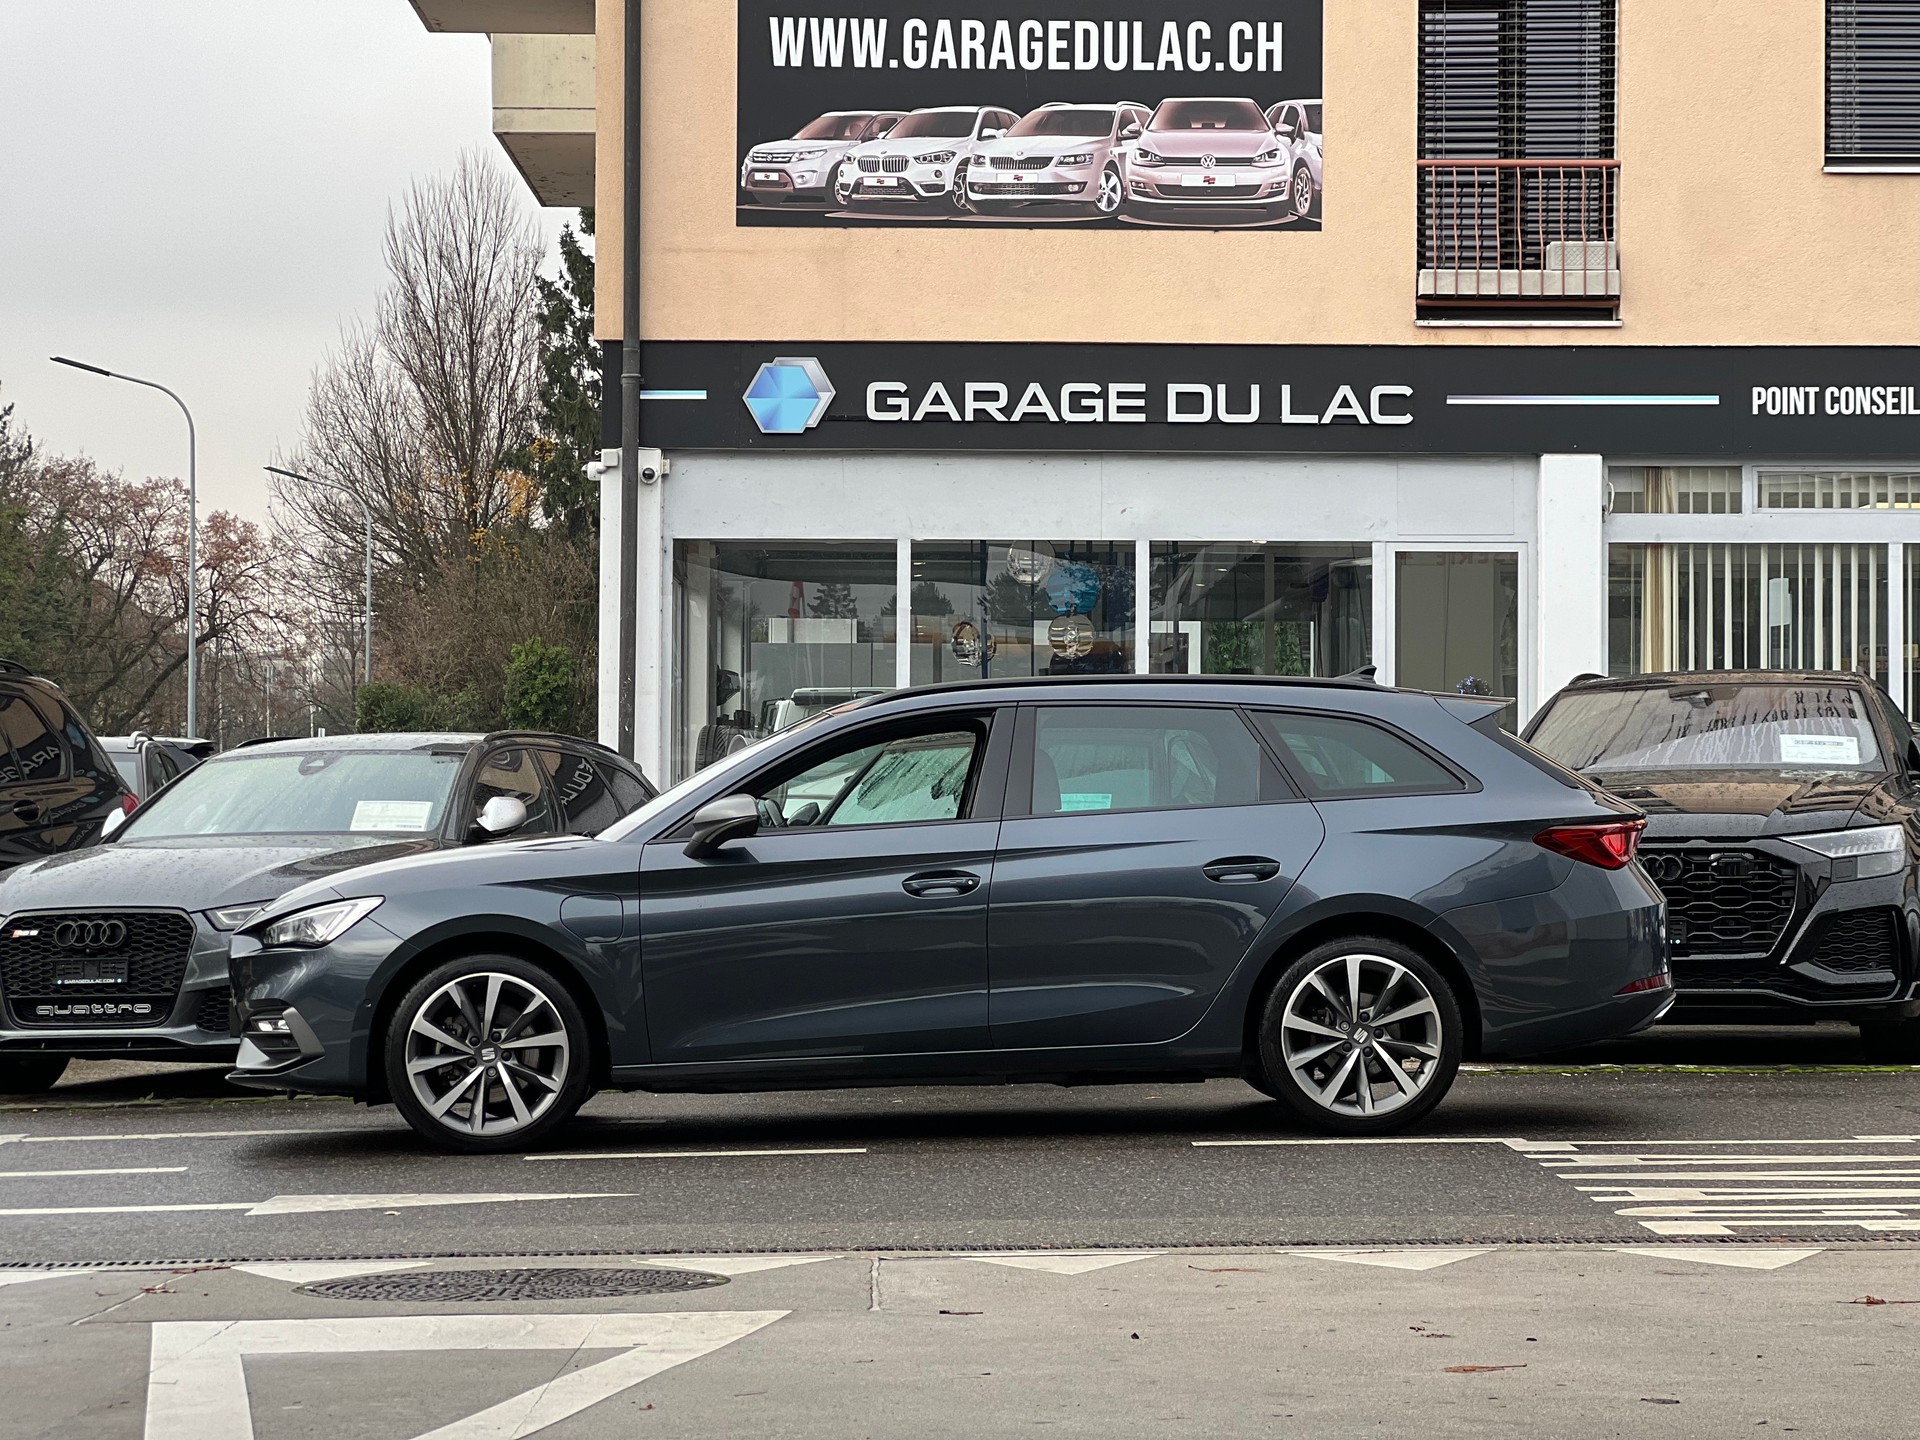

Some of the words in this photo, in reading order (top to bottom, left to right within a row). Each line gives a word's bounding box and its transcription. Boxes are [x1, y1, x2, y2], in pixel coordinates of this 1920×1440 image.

[770, 17, 1283, 71] WWW.GARAGEDULAC.CH
[866, 381, 1146, 424] GARAGE
[1168, 383, 1260, 424] DU
[1280, 384, 1414, 425] LAC
[1752, 386, 1820, 415] POINT
[1825, 386, 1920, 415] CONSEIL
[36, 1003, 152, 1017] quattro
